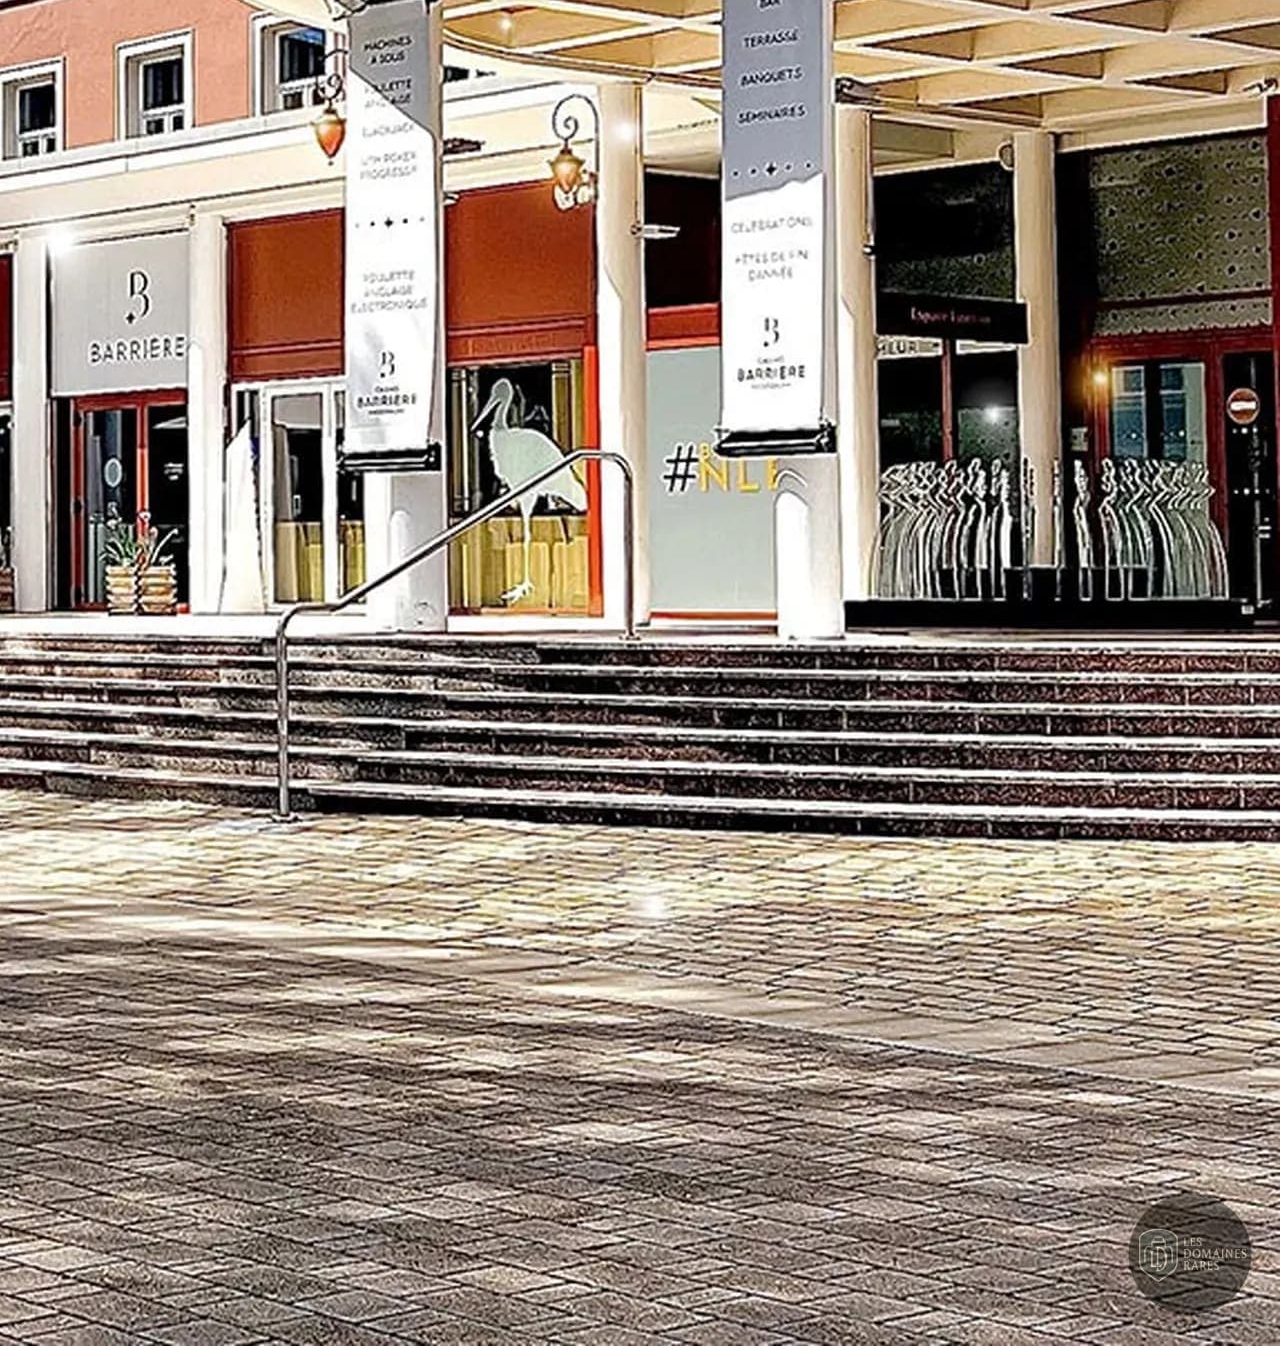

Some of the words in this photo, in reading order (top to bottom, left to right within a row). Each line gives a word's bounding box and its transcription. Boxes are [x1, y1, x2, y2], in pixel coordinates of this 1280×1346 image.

[363, 35, 413, 52] MACHINES
[743, 29, 800, 48] TERRASSE
[740, 67, 803, 87] BANQUETS
